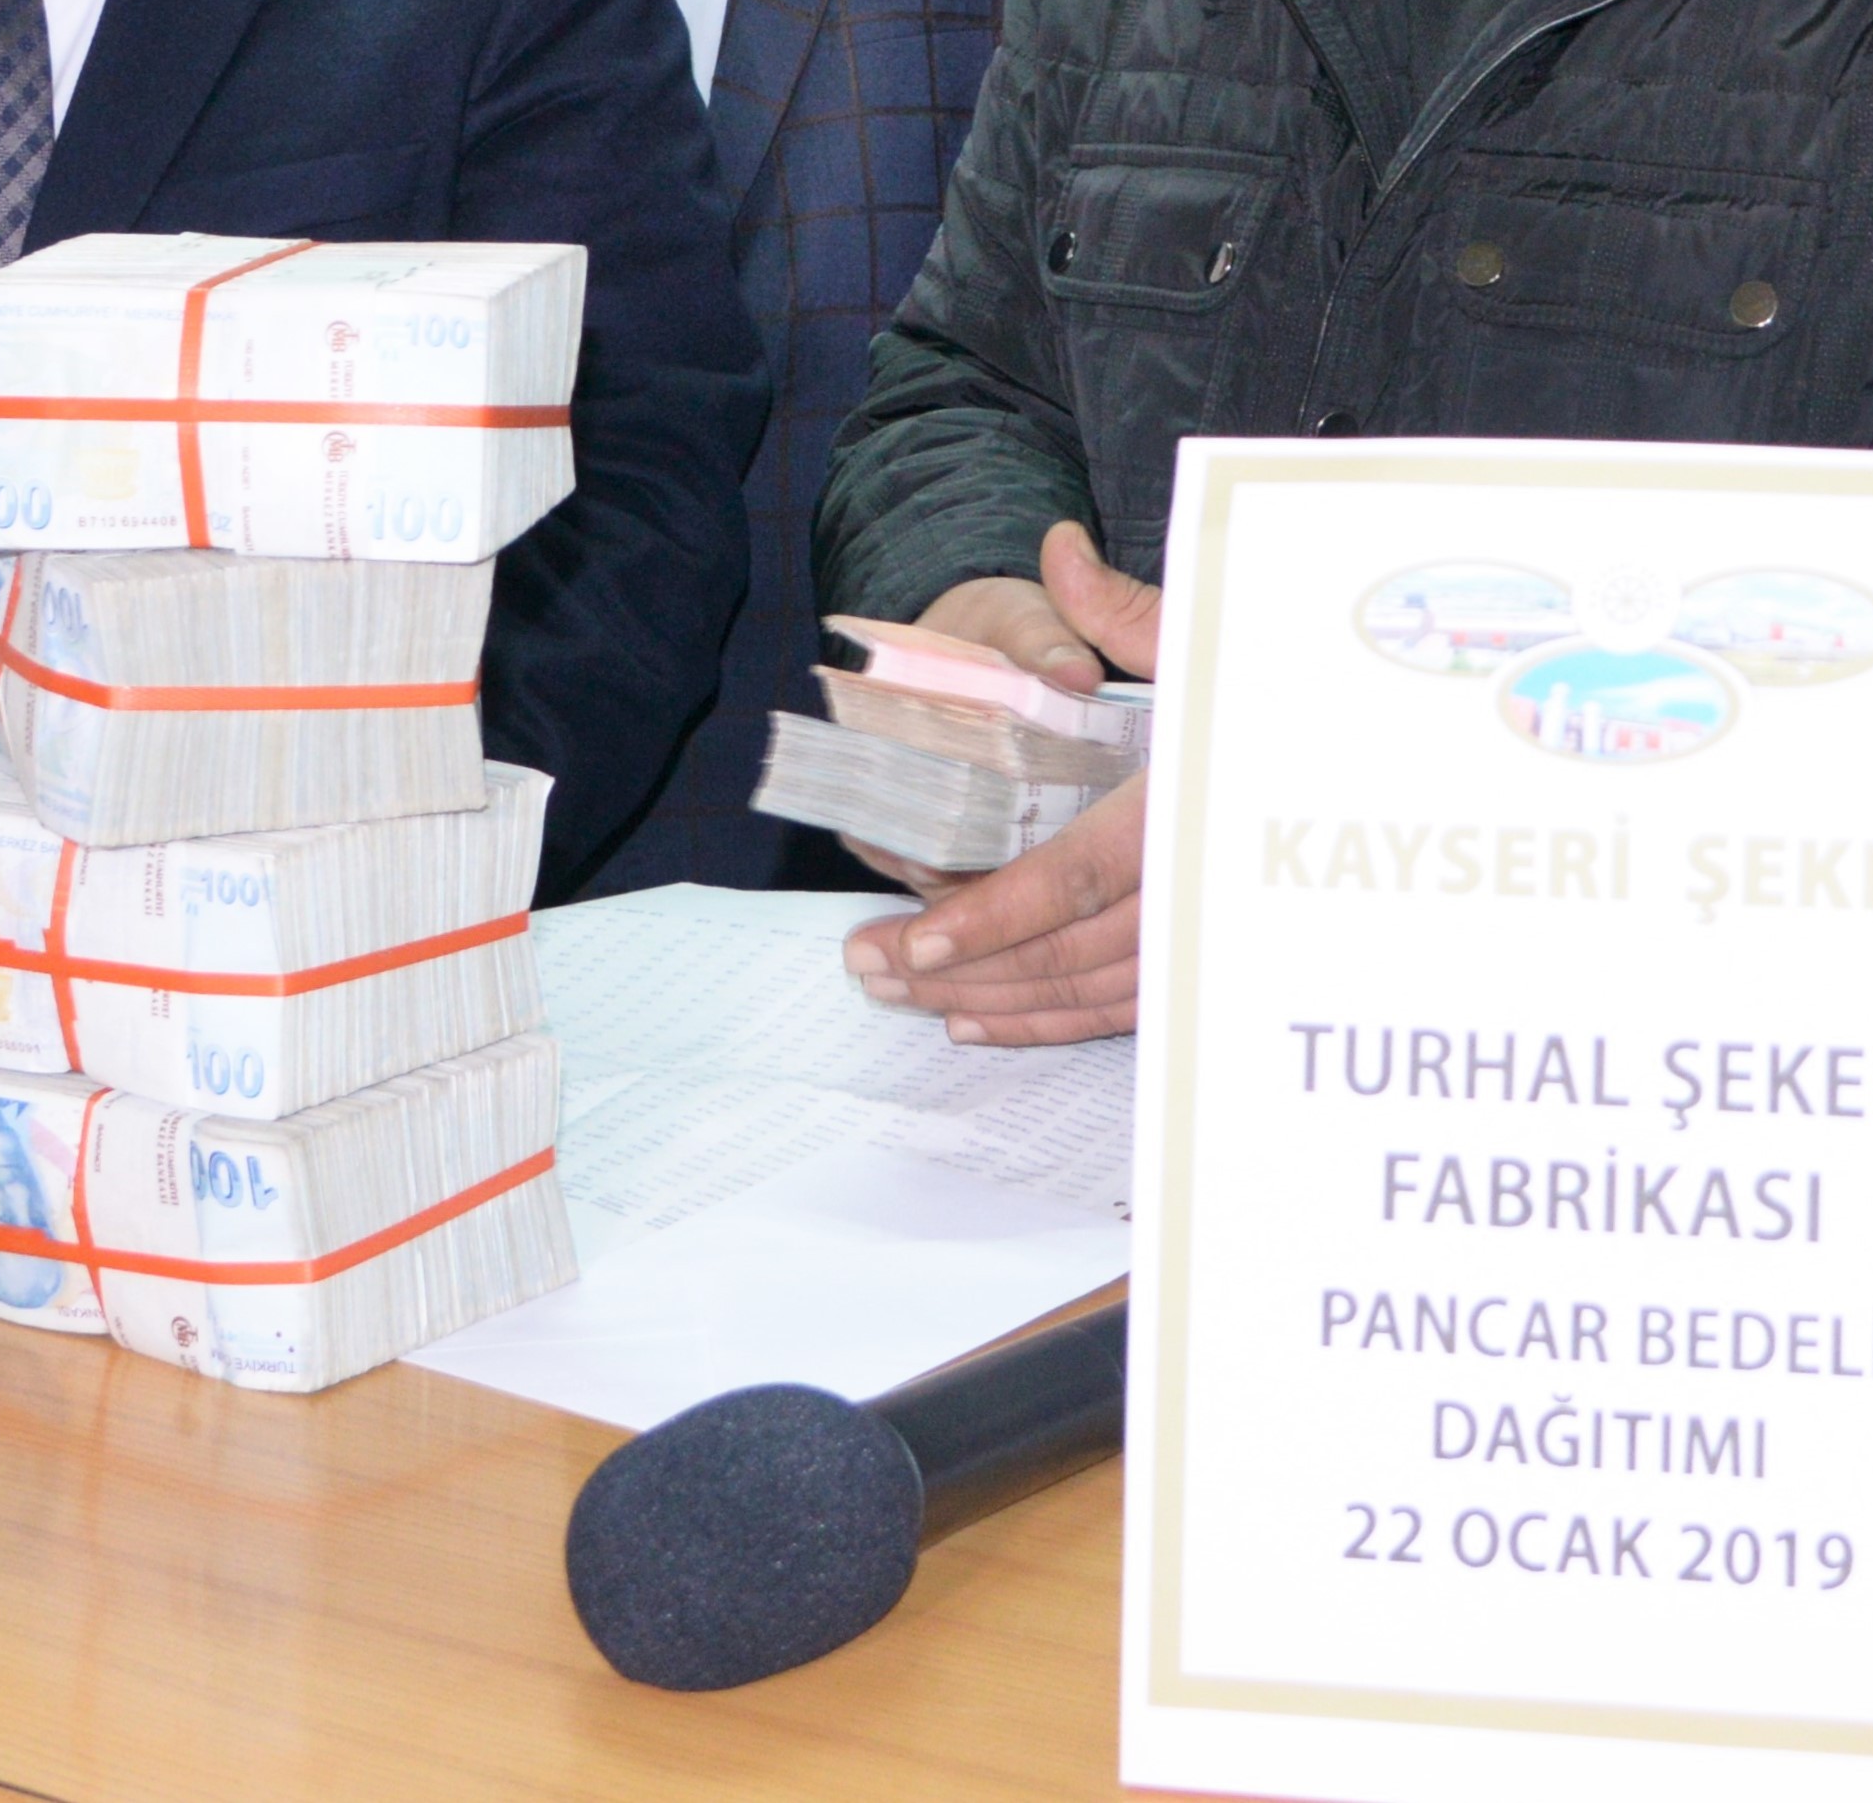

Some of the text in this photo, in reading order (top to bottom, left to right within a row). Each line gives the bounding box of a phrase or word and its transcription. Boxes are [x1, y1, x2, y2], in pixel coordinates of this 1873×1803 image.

[404, 311, 472, 350] 100
[366, 488, 464, 543] 100
[198, 868, 261, 908] 100
[1262, 816, 1631, 901] KAYSERİ
[186, 1040, 266, 1100] 100
[1288, 1022, 1631, 1108] TURHAL
[1381, 1146, 1822, 1242] FABRİKASI
[1320, 1288, 1609, 1363] PANCAR
[1432, 1395, 1767, 1479] DAĞITIMI
[1342, 1503, 1855, 1590] 22 OCAK 2019
